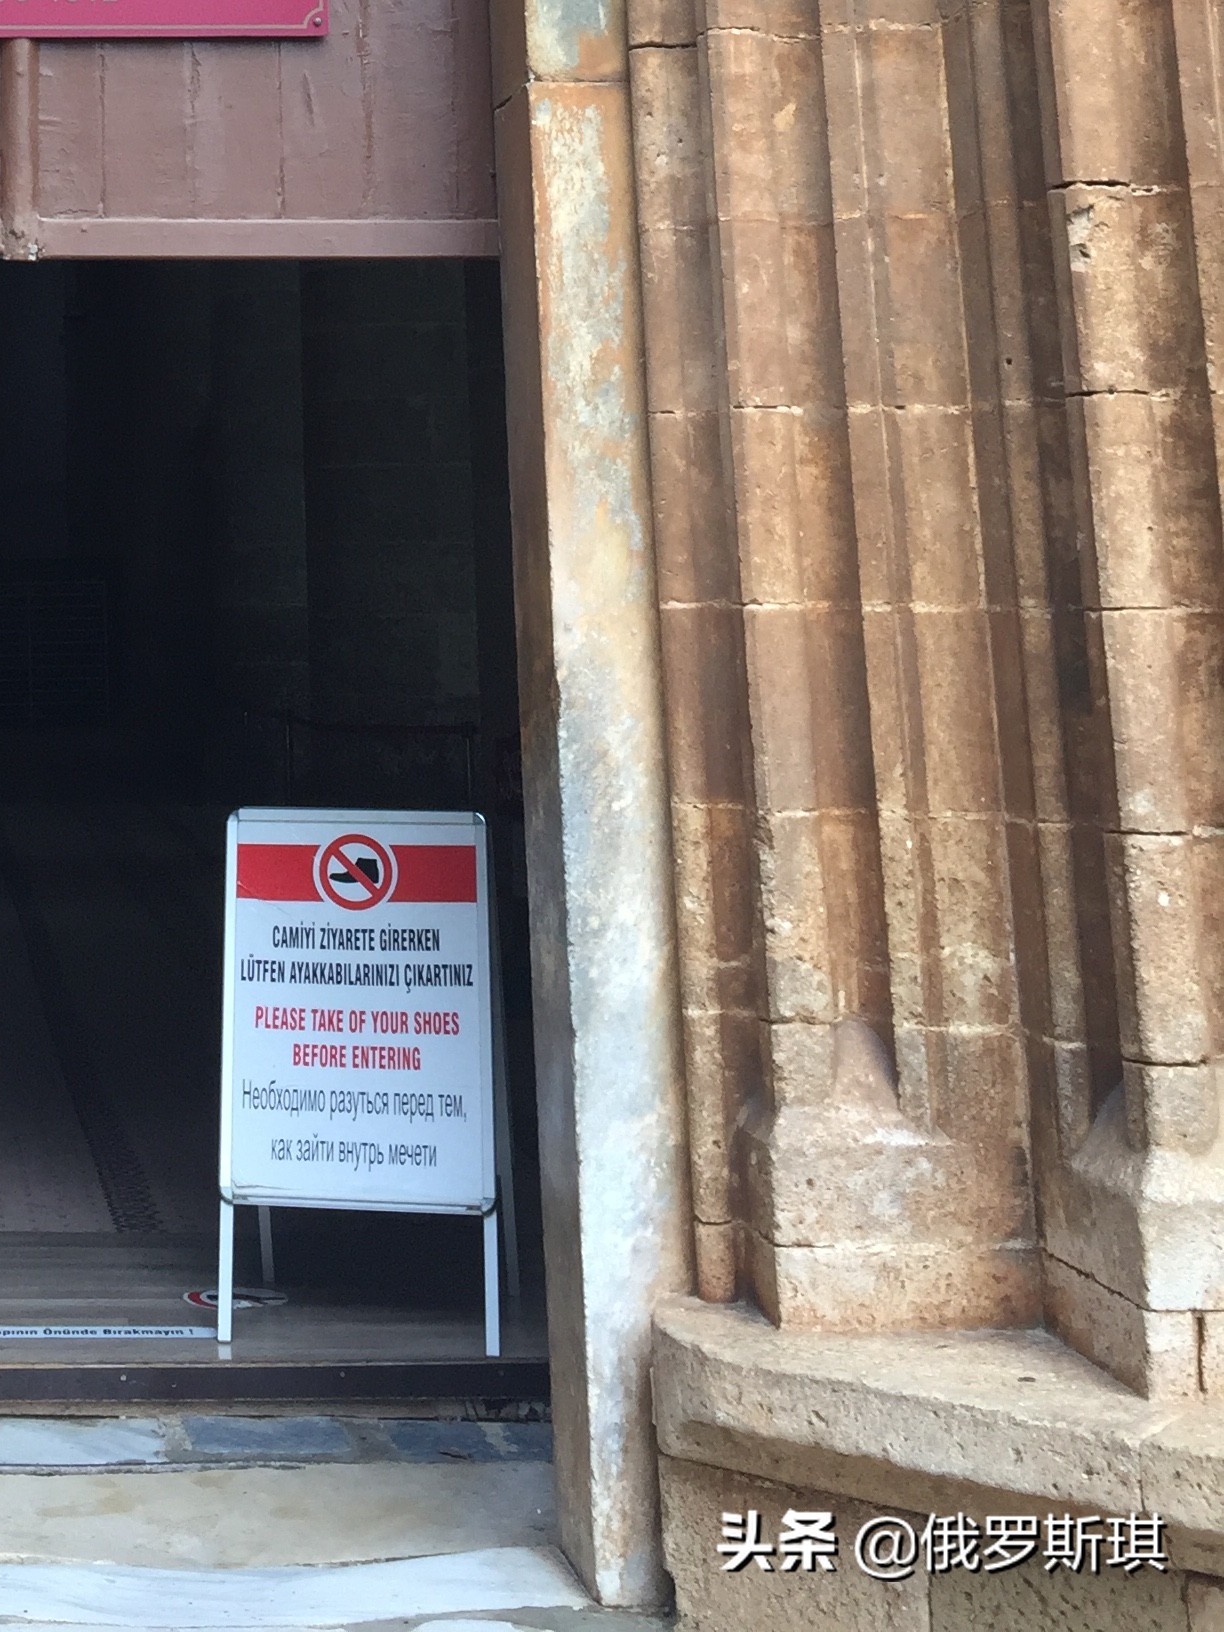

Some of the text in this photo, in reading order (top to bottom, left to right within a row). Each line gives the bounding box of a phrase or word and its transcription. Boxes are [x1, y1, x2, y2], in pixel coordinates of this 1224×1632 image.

[272, 921, 441, 951] CAMİYİ ZİYARETE GİRERKEN
[240, 954, 474, 993] LÜTFEN AYAKKABILARINIZI ÇIKARTINIZ
[255, 1006, 460, 1035] PLEASE TAKE OF YOUR SHOES
[293, 1043, 421, 1070] BEFORE ENTERING
[242, 1079, 467, 1123] Необходимо разуться перед тем,
[271, 1133, 437, 1172] как зайти внутрь мечети
